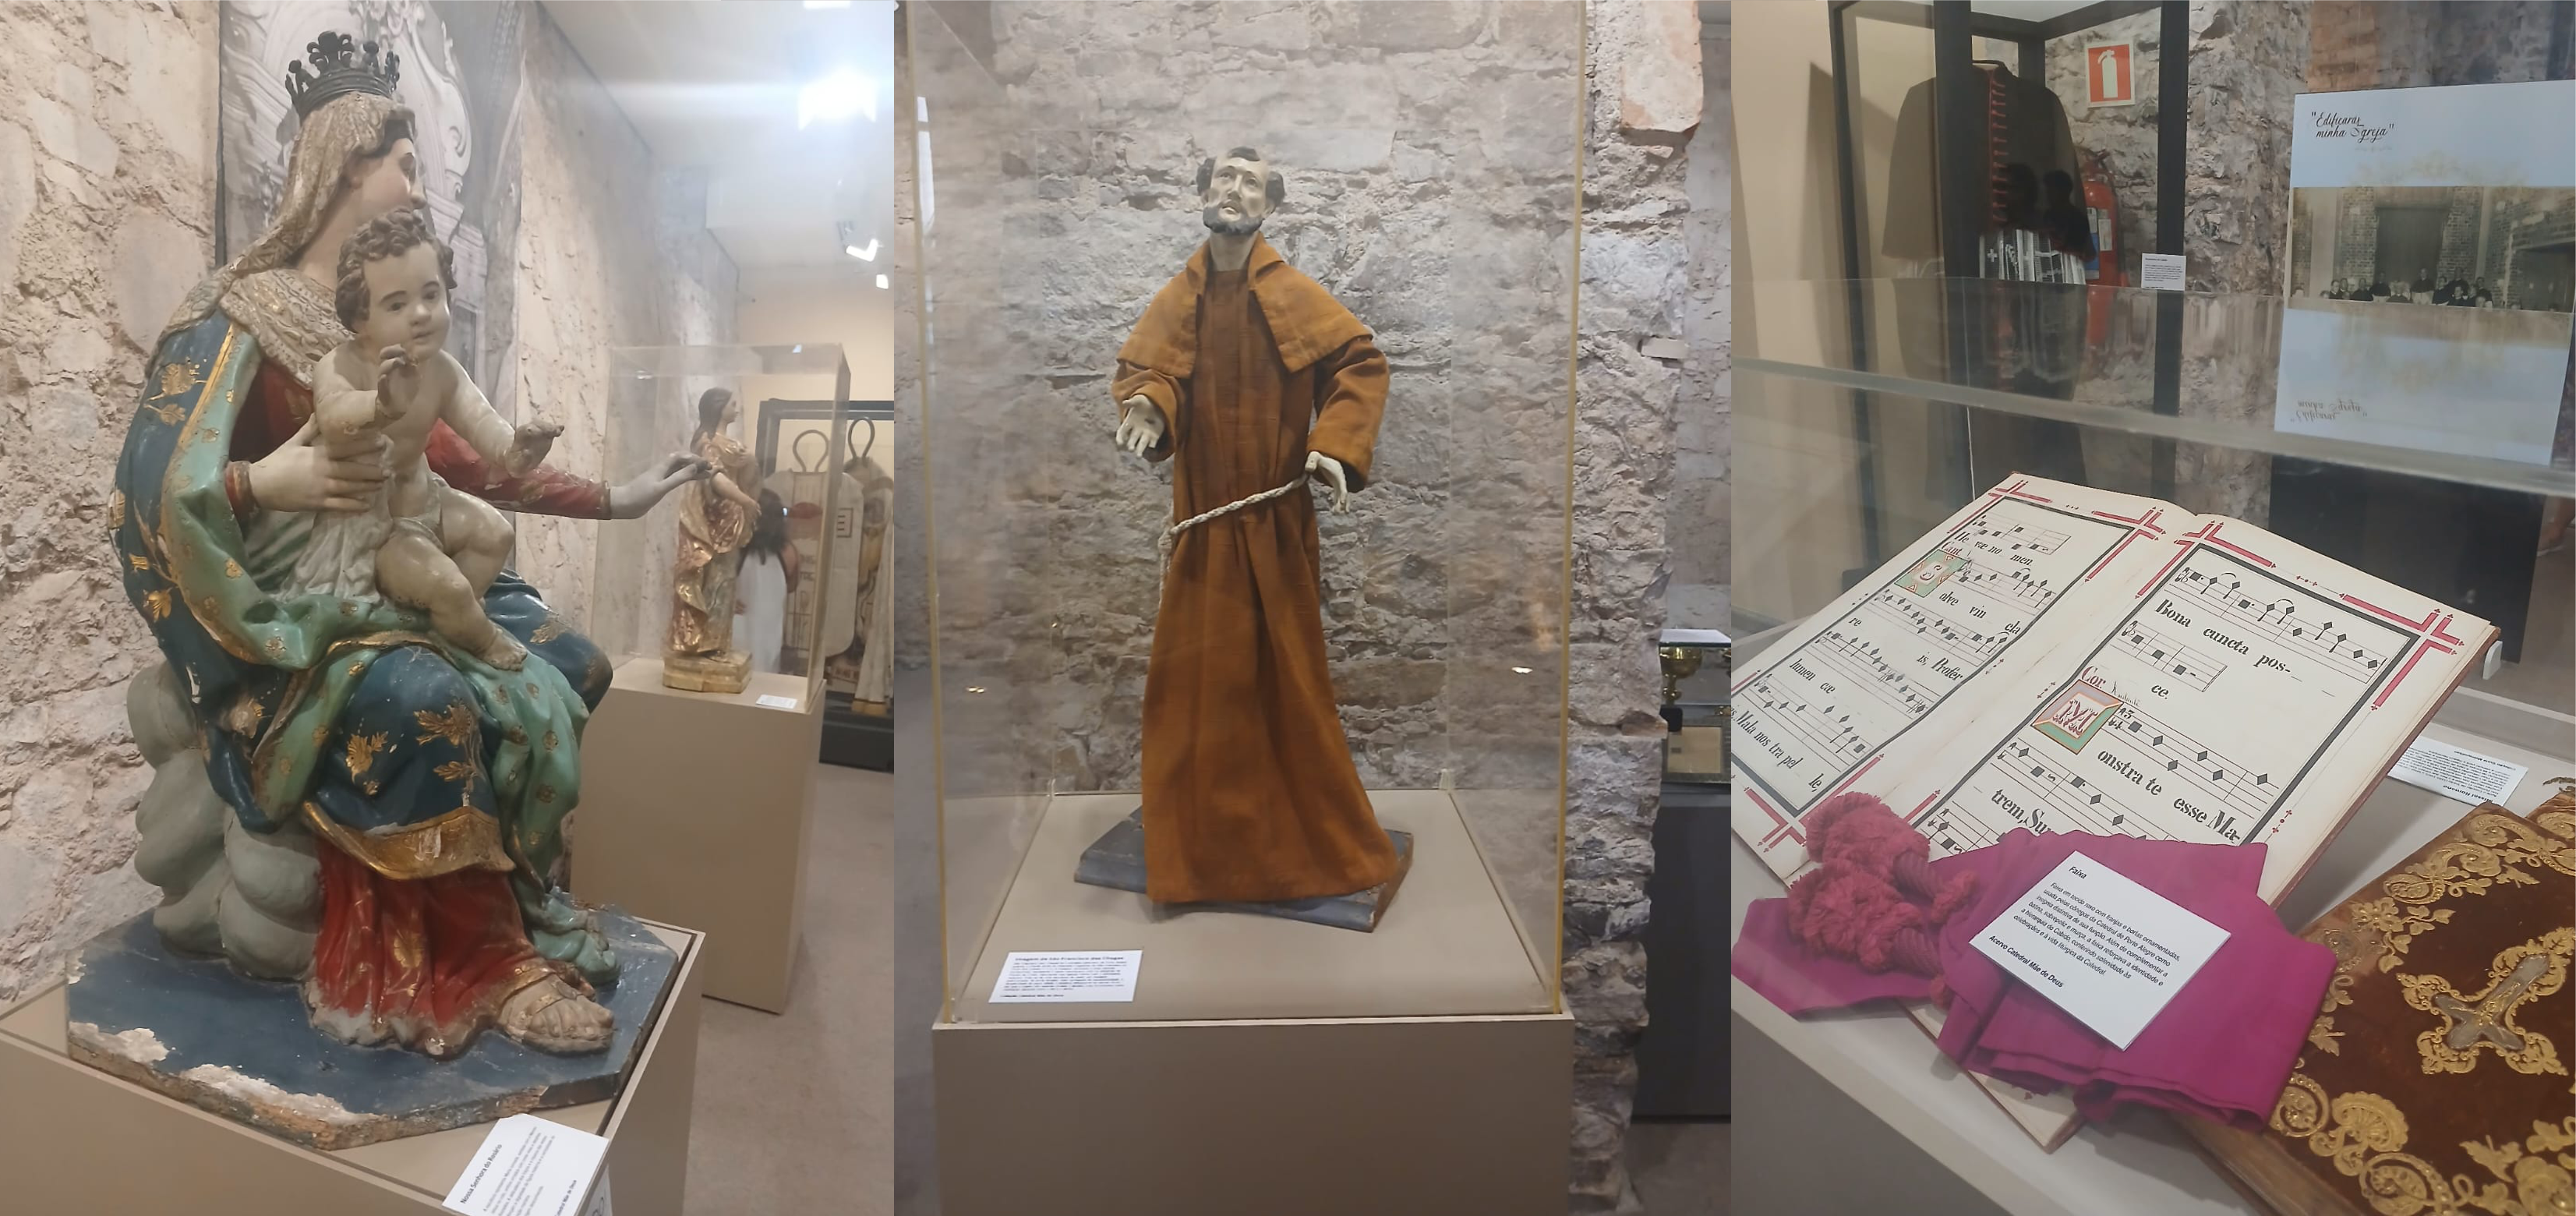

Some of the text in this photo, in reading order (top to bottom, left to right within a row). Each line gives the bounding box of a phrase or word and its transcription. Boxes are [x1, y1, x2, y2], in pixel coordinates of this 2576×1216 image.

[2316, 125, 2346, 137] minha
[1938, 591, 1959, 606] olve
[1969, 605, 1988, 619] vin
[1849, 617, 1862, 627] re
[2155, 599, 2192, 627] Bona
[2203, 627, 2249, 655] cuncta
[1789, 658, 1816, 681] lumen
[2081, 666, 2106, 689] Cor.
[1754, 731, 1771, 747] nos
[1777, 755, 1804, 769] pel
[2097, 751, 2143, 785] onstra
[2145, 778, 2162, 796] te
[2173, 797, 2207, 823] esse
[2068, 866, 2087, 878] Faixa
[2048, 936, 2058, 945] vida
[2095, 920, 2118, 935] Catedral
[2123, 935, 2138, 947] Porto
[2136, 944, 2155, 957] Alegre
[2154, 955, 2170, 966] como
[1988, 935, 2008, 949] Acervo
[2006, 947, 2030, 964] Catedral
[2028, 961, 2041, 972] Mãe
[2047, 974, 2063, 987] Deus
[2125, 949, 2164, 974] complementar
[459, 1187, 474, 1204] Nossa
[470, 1168, 487, 1188] Senhora
[487, 1144, 502, 1161] Rosário
